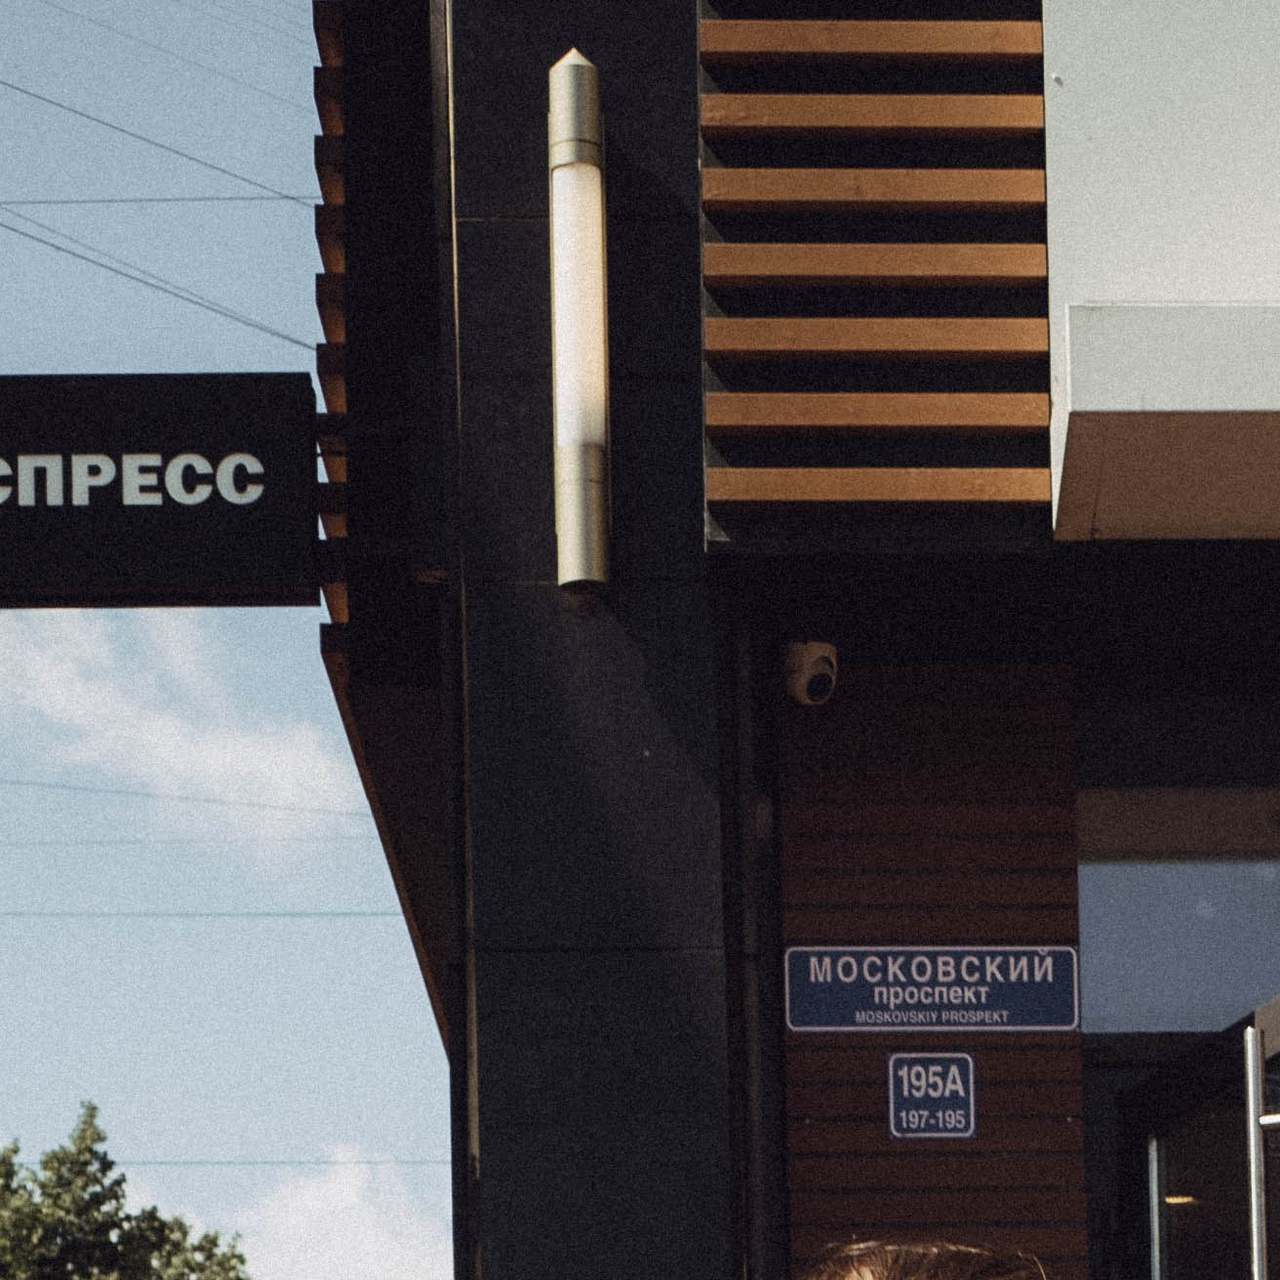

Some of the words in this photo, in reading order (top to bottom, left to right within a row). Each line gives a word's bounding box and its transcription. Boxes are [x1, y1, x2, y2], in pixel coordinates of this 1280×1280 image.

[0, 453, 264, 506] ПРЕСС
[809, 948, 1054, 984] МОСКОВСКИЙ
[873, 985, 990, 1009] проспект
[855, 1010, 938, 1024] MOSKOVSKIY
[942, 1010, 1010, 1024] PROSPEKT
[899, 1065, 966, 1099] 195А
[899, 1110, 966, 1130] 197-195
